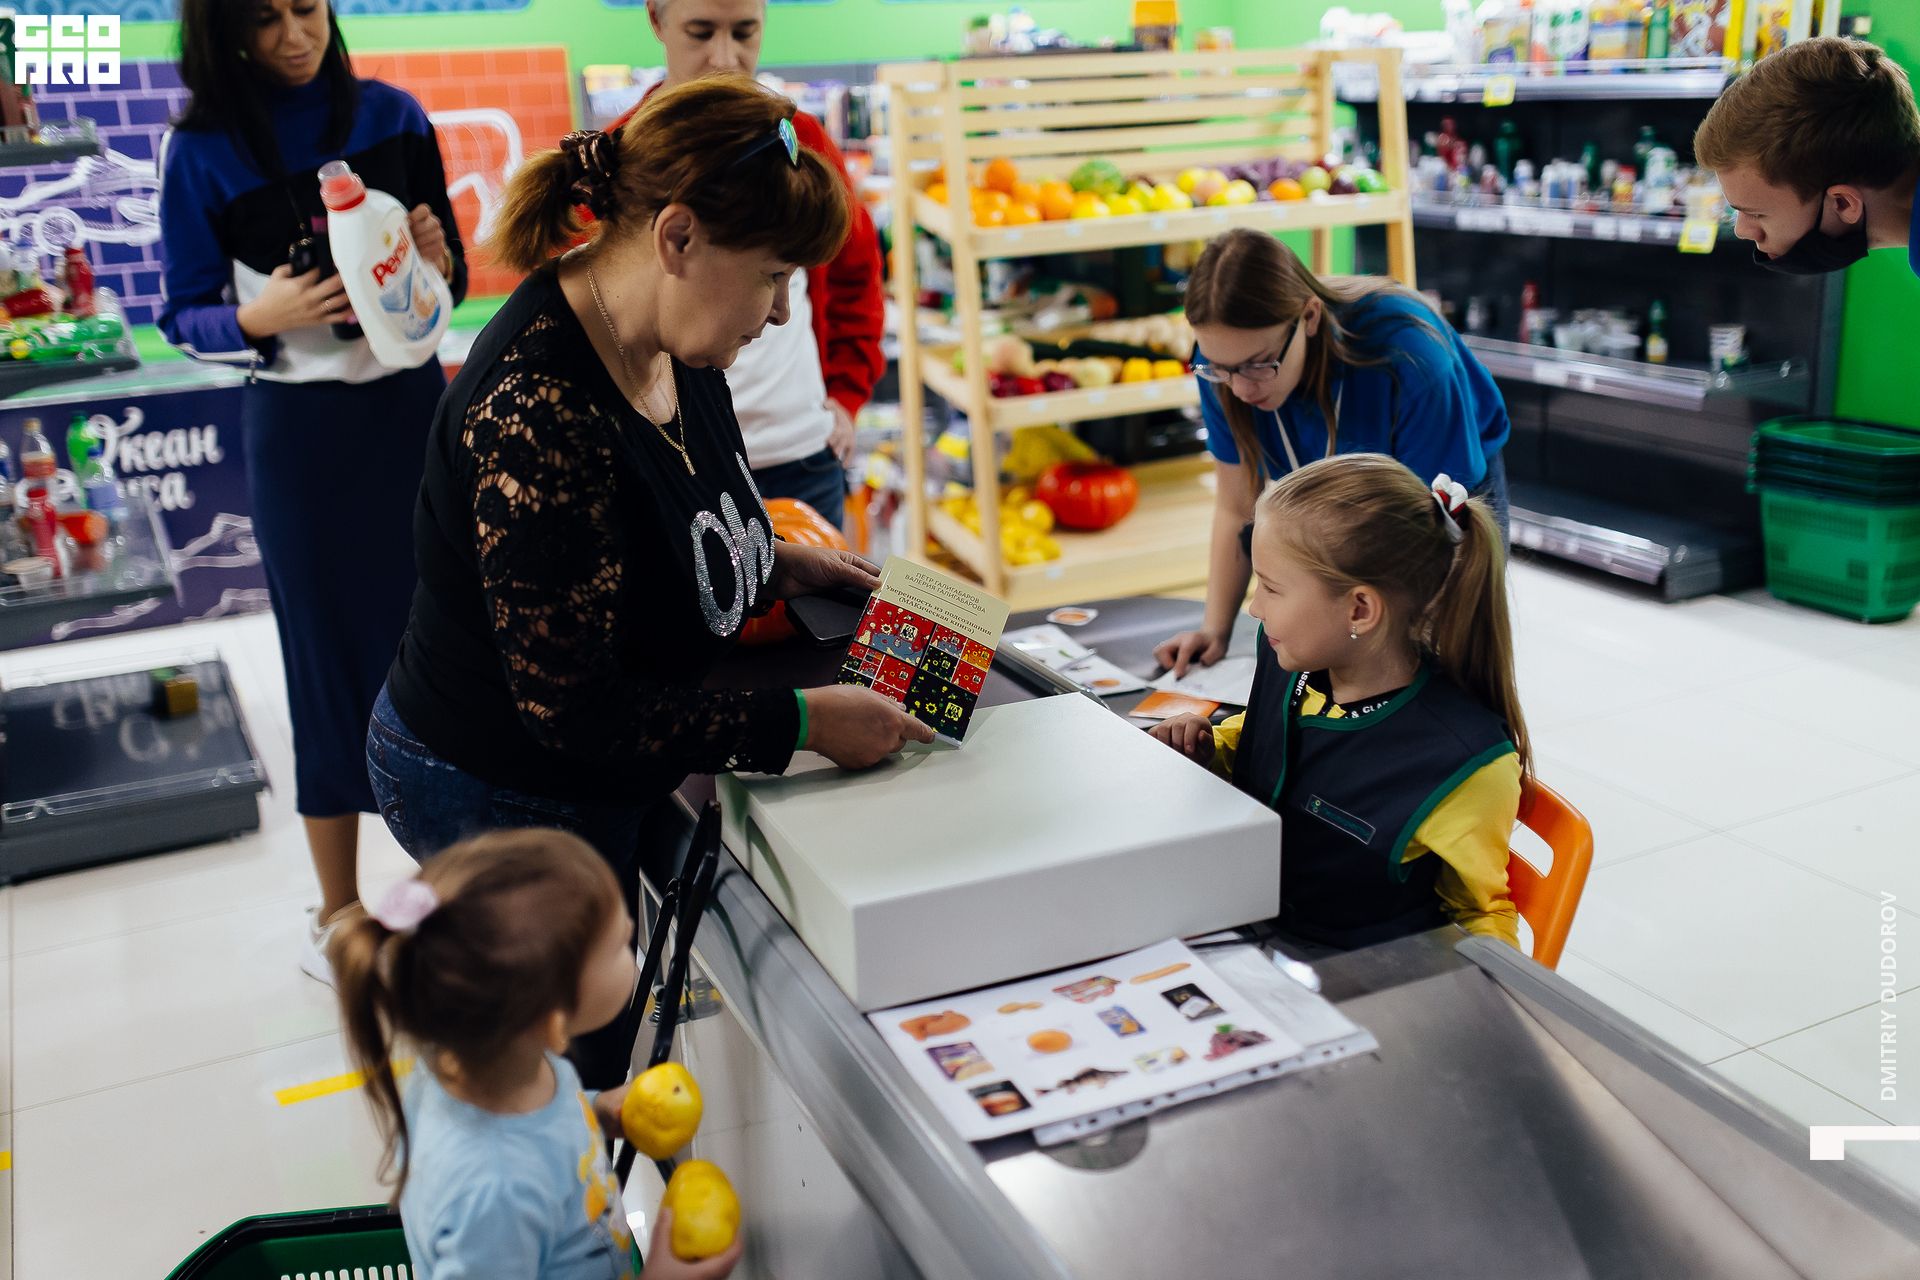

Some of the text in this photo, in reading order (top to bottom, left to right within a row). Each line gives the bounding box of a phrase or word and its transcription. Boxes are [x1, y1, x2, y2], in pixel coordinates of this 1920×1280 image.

[371, 226, 410, 287] Persil
[886, 584, 992, 636] Уверенность из подсознания
[904, 574, 987, 613] ВАЛЕРИЯ ГАЛИГАБАРОВА
[934, 578, 980, 604] ГАЛИГАБАРОВ
[949, 620, 975, 635] книга)
